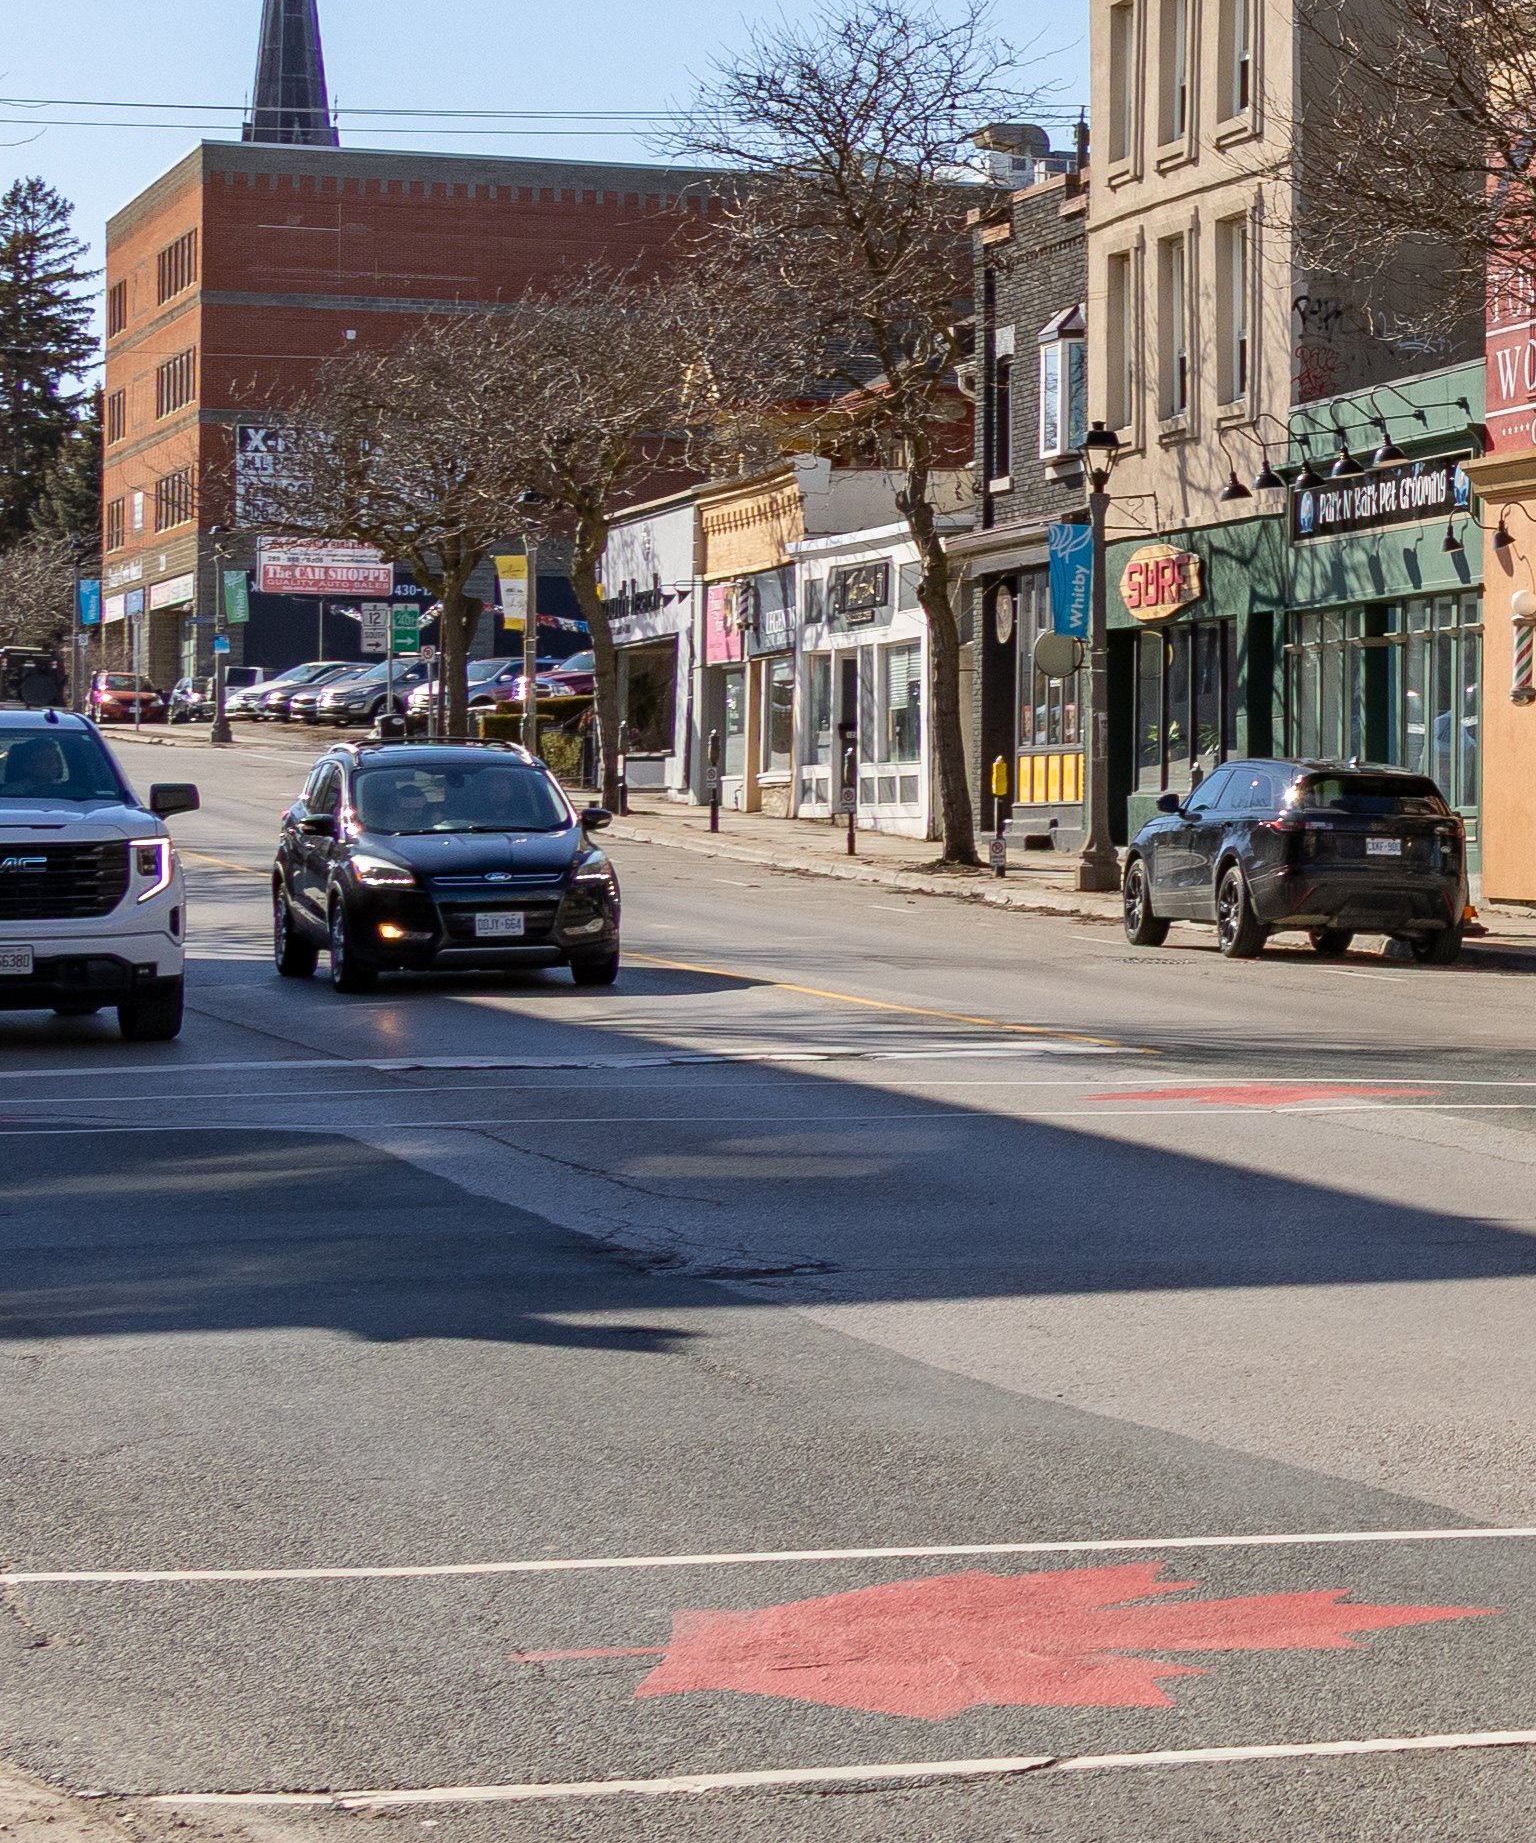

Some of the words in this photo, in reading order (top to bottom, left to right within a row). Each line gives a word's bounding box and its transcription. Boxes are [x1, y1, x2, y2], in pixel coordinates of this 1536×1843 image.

[1380, 480, 1398, 513] Pet
[1400, 469, 1447, 509] Grooming
[266, 566, 292, 579] The
[295, 566, 326, 580] CAR
[328, 568, 388, 582] SHOPPE
[267, 579, 315, 587] QUALITY
[1127, 555, 1190, 607] SURF
[1069, 564, 1091, 628] Whitby
[368, 612, 380, 625] 12
